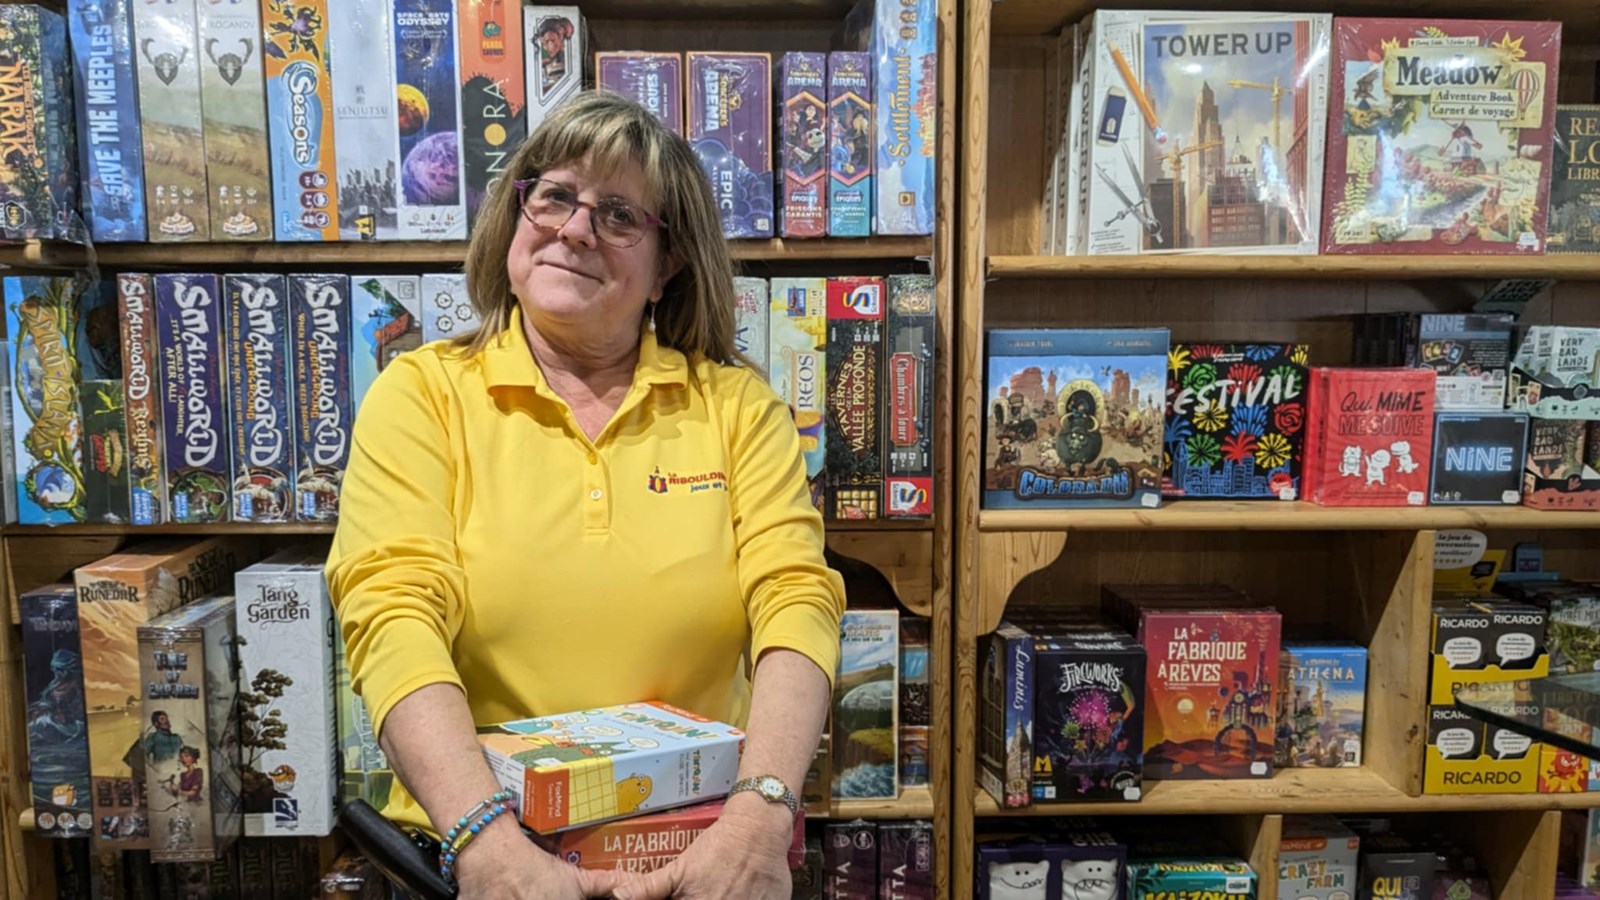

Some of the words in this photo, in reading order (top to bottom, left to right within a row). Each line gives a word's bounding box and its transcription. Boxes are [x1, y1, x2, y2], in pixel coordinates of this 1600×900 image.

[397, 18, 450, 26] ODYSSEY
[1152, 33, 1249, 57] TOWER
[1255, 32, 1293, 54] UP
[87, 24, 117, 105] MEEPLES
[1395, 56, 1503, 87] Meadow
[787, 77, 822, 87] ARENA
[832, 77, 867, 87] ARENA
[703, 69, 719, 132] ARENA
[889, 54, 911, 158] Settlement
[1436, 91, 1488, 102] Adventure
[1489, 92, 1514, 102] Book
[287, 71, 318, 165] Seasons
[1080, 61, 1090, 169] TOWER
[1432, 106, 1464, 115] Carnet
[1468, 105, 1480, 115] de
[1483, 107, 1515, 118] voyage
[89, 109, 121, 146] THE
[1570, 117, 1600, 136] RE
[96, 142, 122, 197] SAVE
[721, 170, 733, 210] EPIC
[1079, 175, 1087, 216] UP
[870, 286, 879, 313] Schmidt
[296, 312, 305, 339] WHEN
[26, 306, 69, 374] SPIRIT
[298, 340, 305, 352] IN
[1559, 347, 1578, 356] BAD
[1560, 337, 1585, 347] VERY
[165, 346, 176, 379] AFTER
[175, 343, 184, 372] WORLD
[1557, 356, 1588, 367] LANDS
[177, 373, 185, 385] OF
[243, 340, 256, 421] UNDERGROUND
[308, 340, 320, 419] UNDERGROUND
[852, 345, 866, 406] PROFONDE
[895, 358, 910, 407] Chambres
[167, 382, 177, 403] ALL!
[836, 361, 853, 436] TAVERNES
[36, 375, 70, 450] ISLAND
[1338, 414, 1365, 436] ME
[1366, 413, 1425, 436] SUIVE
[131, 401, 154, 471] Realms
[851, 411, 866, 452] VALLÉE
[897, 417, 908, 441] louer
[1535, 436, 1553, 445] BAD
[1533, 445, 1563, 455] LANDS
[891, 483, 899, 510] Schmidt
[1447, 534, 1460, 542] jeu
[258, 584, 299, 608] Tang
[247, 601, 310, 623] Garden
[1440, 618, 1489, 629] RICARDO
[1493, 614, 1543, 625] RICARDO
[1174, 627, 1188, 640] LA
[1168, 641, 1247, 660] FABRIQUE
[1013, 644, 1031, 711] Luminis
[1060, 661, 1124, 692] FIREWORKS
[1157, 660, 1168, 679] À
[1169, 660, 1222, 682] RÊVES
[1287, 667, 1355, 681] ATHENA
[1443, 771, 1522, 785] RICARDO
[554, 780, 563, 818] FoxMind
[604, 834, 624, 852] LA
[1278, 860, 1327, 880] CRAZY
[1306, 873, 1345, 889] FARM
[1373, 877, 1402, 895] QUI
